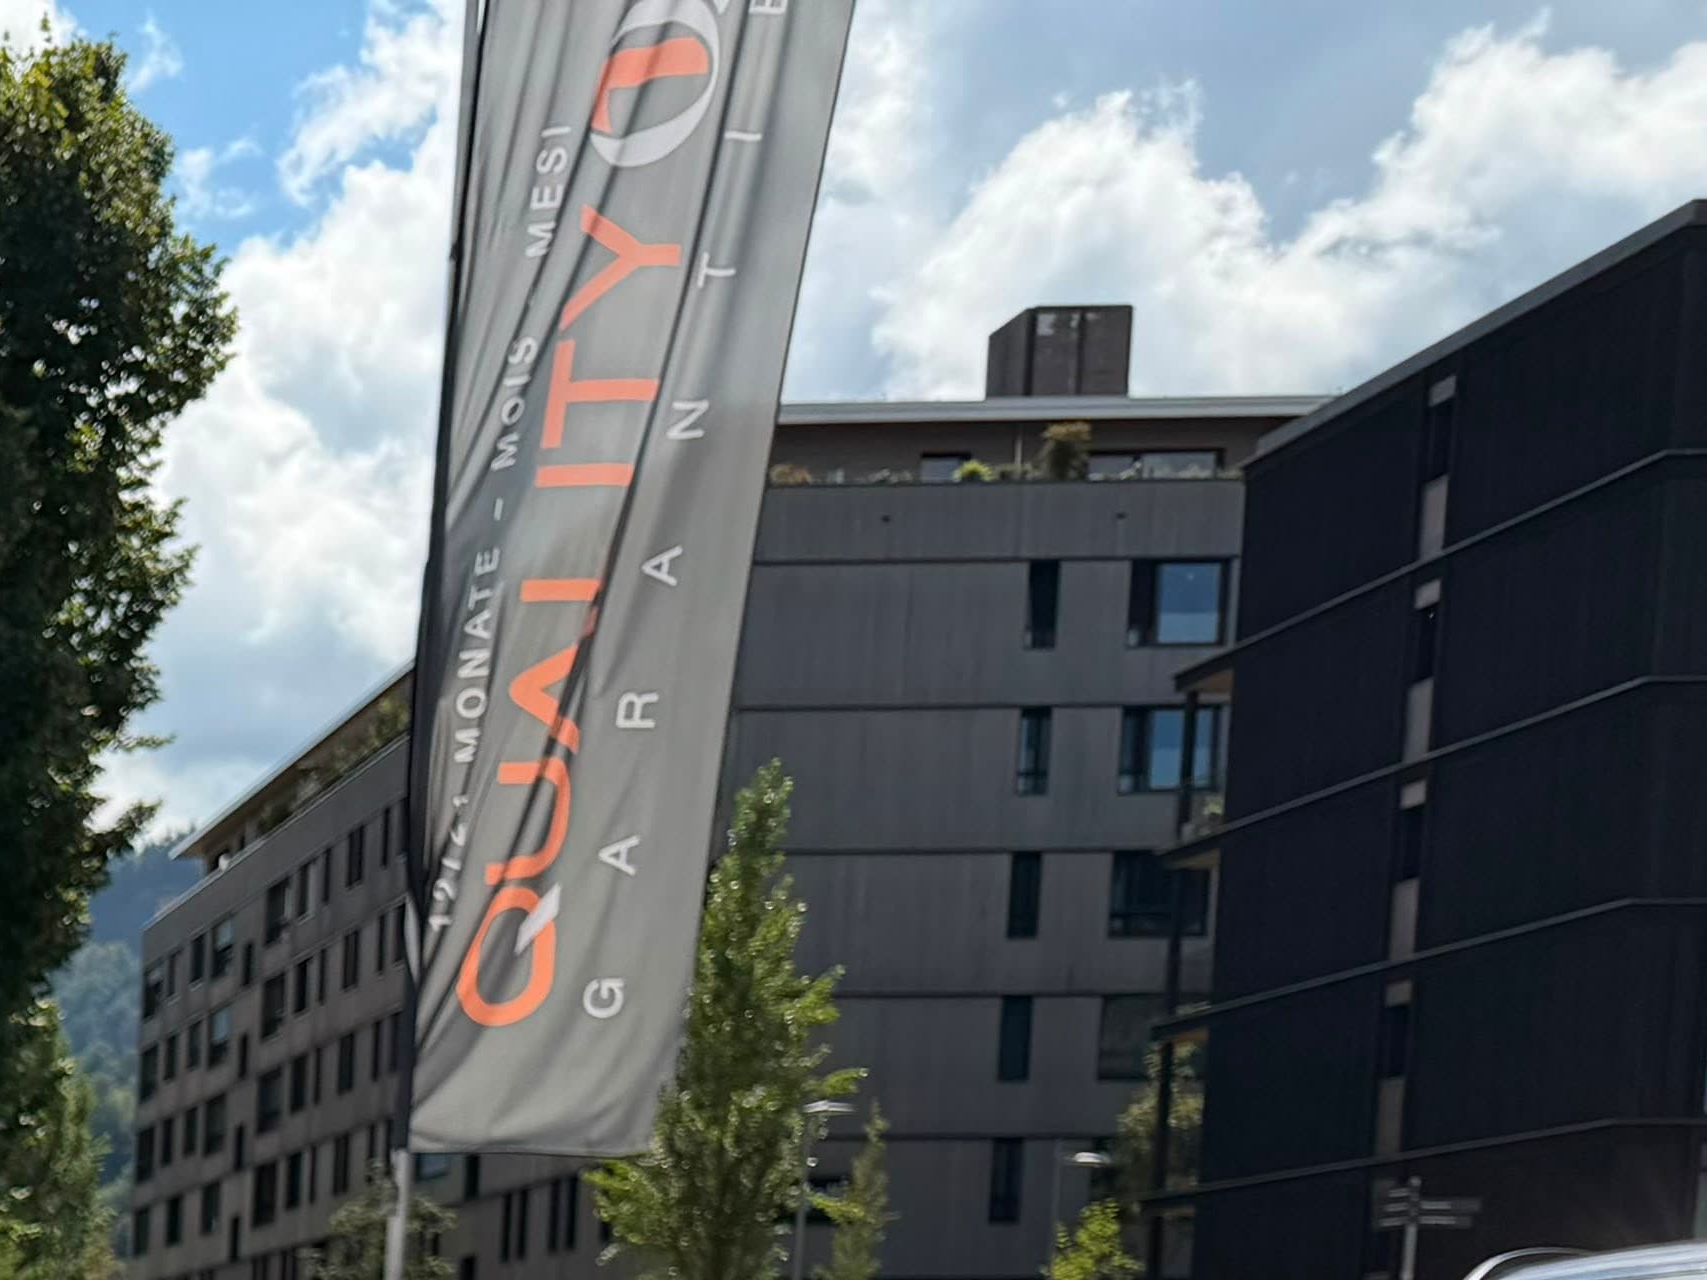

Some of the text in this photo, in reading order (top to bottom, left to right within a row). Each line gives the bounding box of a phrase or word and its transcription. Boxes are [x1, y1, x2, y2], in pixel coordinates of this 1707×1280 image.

[454, 547, 500, 763] MONATE
[490, 335, 538, 471] MOIS
[526, 125, 572, 259] MESI
[456, 205, 682, 1027] QUALITY
